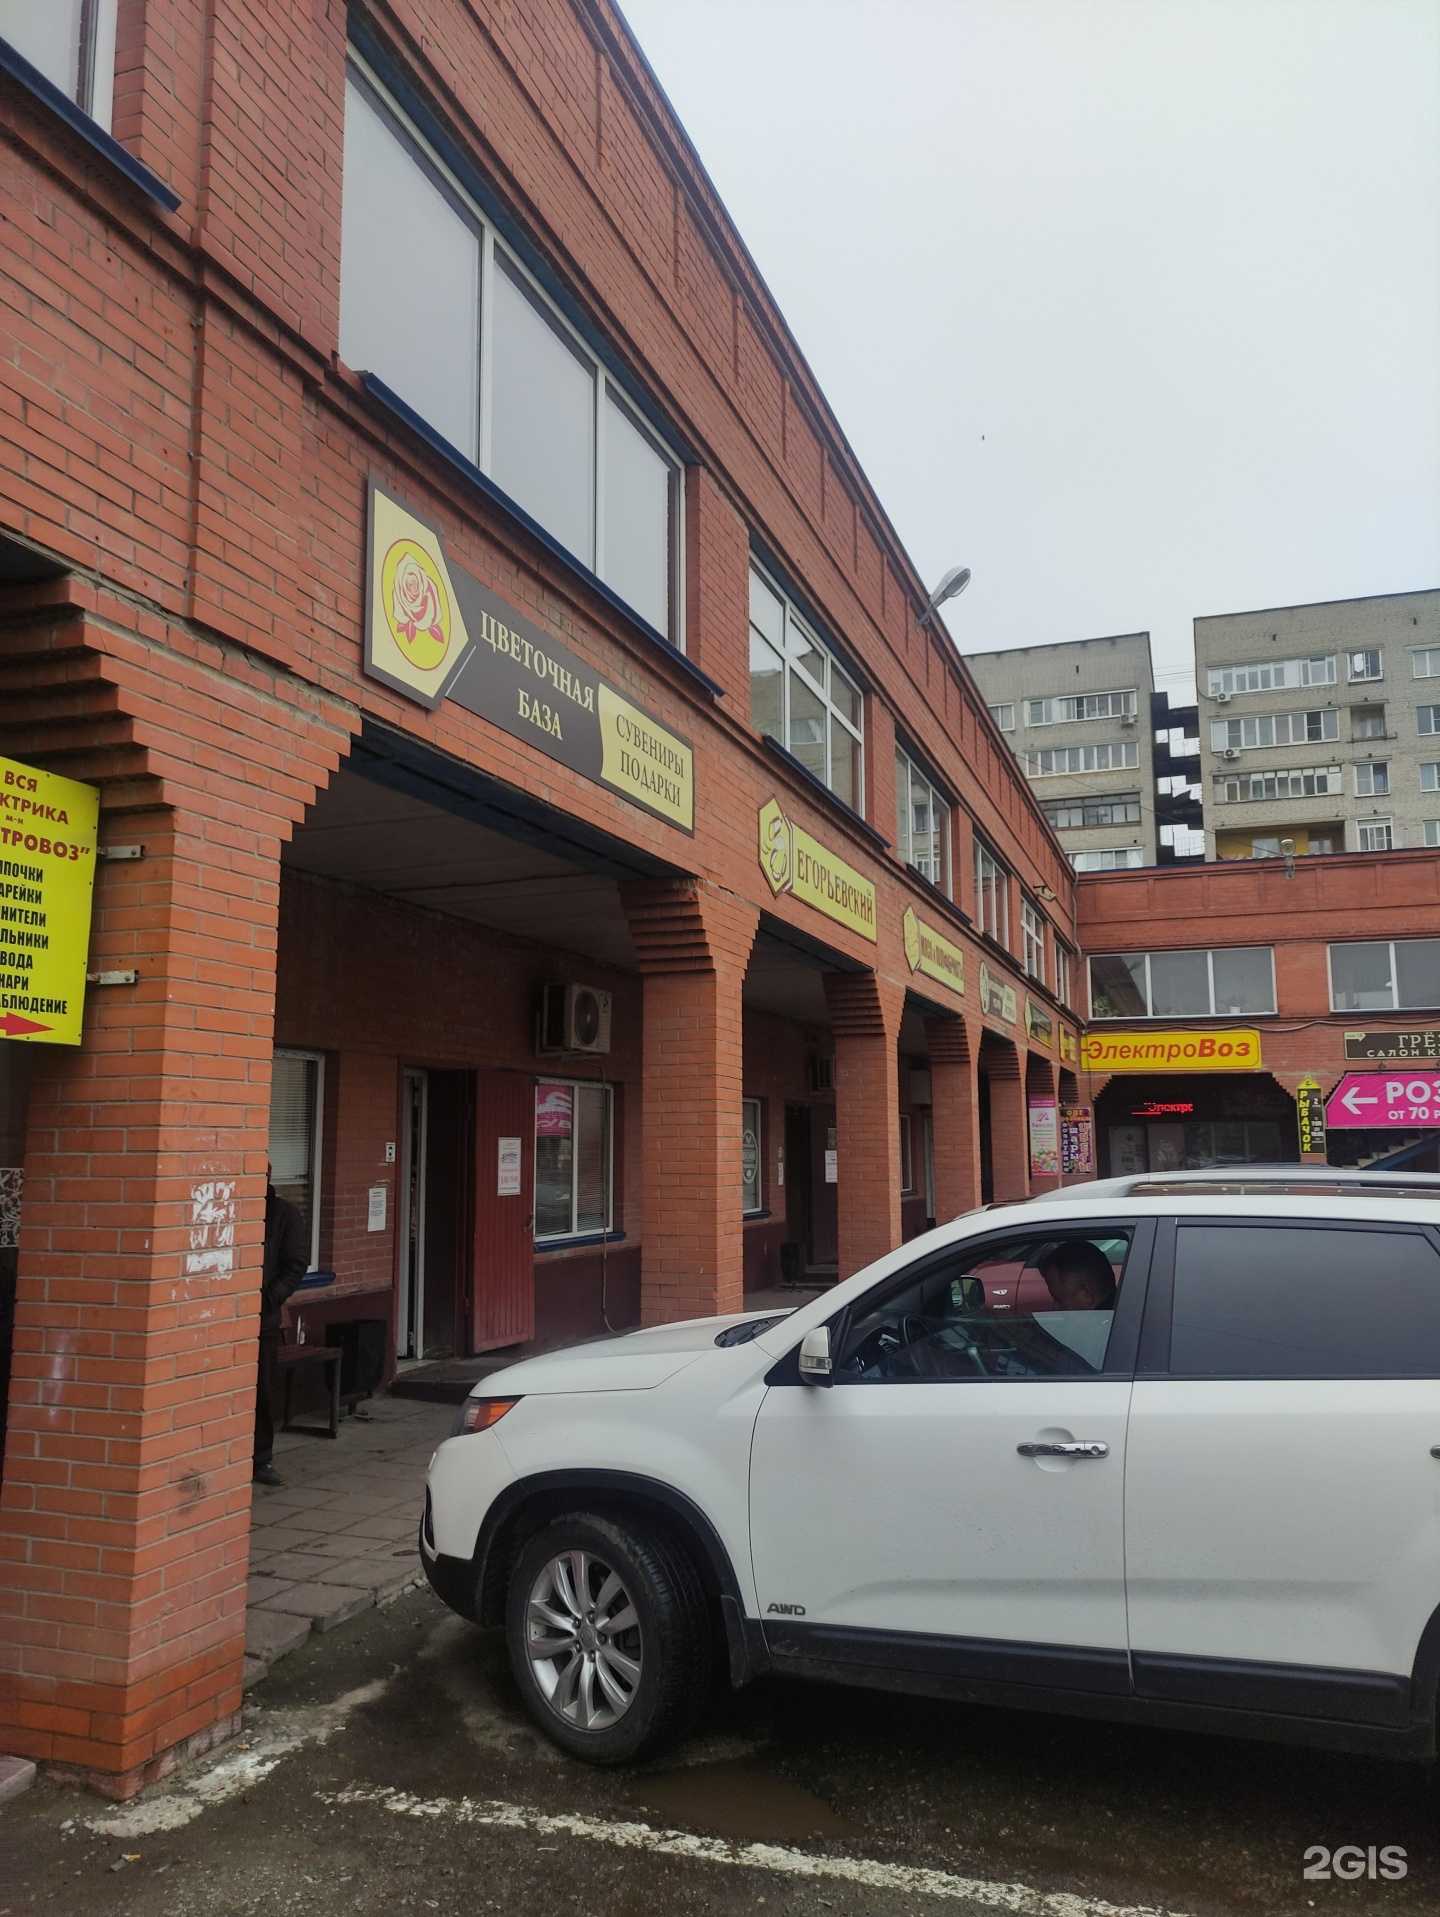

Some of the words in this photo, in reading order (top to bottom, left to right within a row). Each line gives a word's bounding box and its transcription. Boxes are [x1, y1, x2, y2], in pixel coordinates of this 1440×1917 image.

[480, 609, 594, 713] ЦВЕТОЧНАЯ
[518, 688, 563, 741] БАЗА
[616, 713, 684, 778] СУВЕНИРЫ
[4, 770, 38, 792] ВСЯ
[620, 750, 681, 807] ПОДАРКИ
[0, 792, 69, 825] КТРИКА
[797, 848, 873, 925] ЕГОРЬЕВСКИЙ
[1, 905, 47, 927] НИТЕЛИ
[0, 928, 49, 949] ЛЬНИКИ
[0, 951, 33, 970] ВОДА
[0, 993, 68, 1015] БЛЮДЕНИЕ
[1088, 1038, 1250, 1062] ЭлектроВоз
[1398, 1031, 1440, 1048] ГРЁ
[1366, 1048, 1420, 1057] САЛОН
[1427, 1048, 1440, 1056] К
[1299, 1090, 1312, 1152] РЫБАЧОК
[1408, 1106, 1430, 1120] 70
[767, 1603, 806, 1616] AWD
